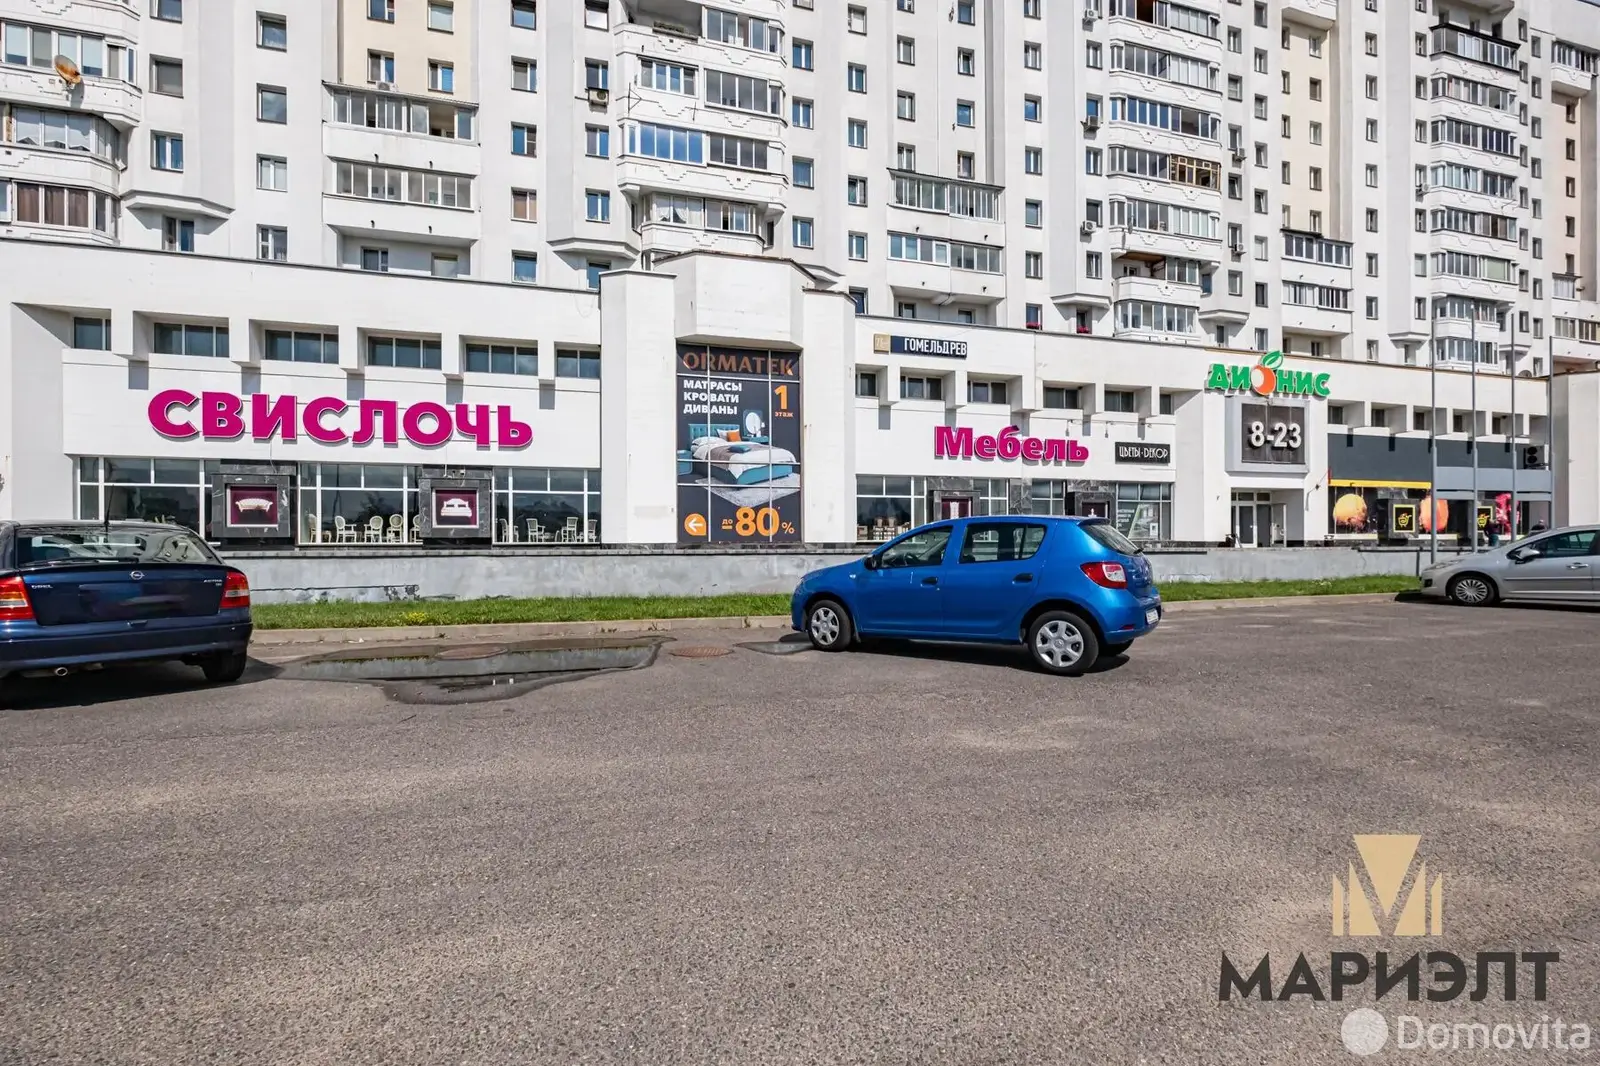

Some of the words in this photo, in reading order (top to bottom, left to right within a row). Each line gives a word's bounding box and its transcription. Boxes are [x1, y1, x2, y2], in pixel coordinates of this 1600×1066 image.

[903, 337, 967, 356] ГОМЕЛЬДРЕВ
[682, 351, 794, 376] ORMATEK
[683, 379, 743, 392] МАТРАСЫ
[683, 391, 740, 404] КРОВАТИ
[774, 384, 788, 410] 1
[147, 388, 534, 450] СВИСЛОЧЬ
[683, 403, 738, 415] ДИВАНЫ
[934, 424, 1091, 463] Мебель
[1251, 420, 1302, 449] 8-23
